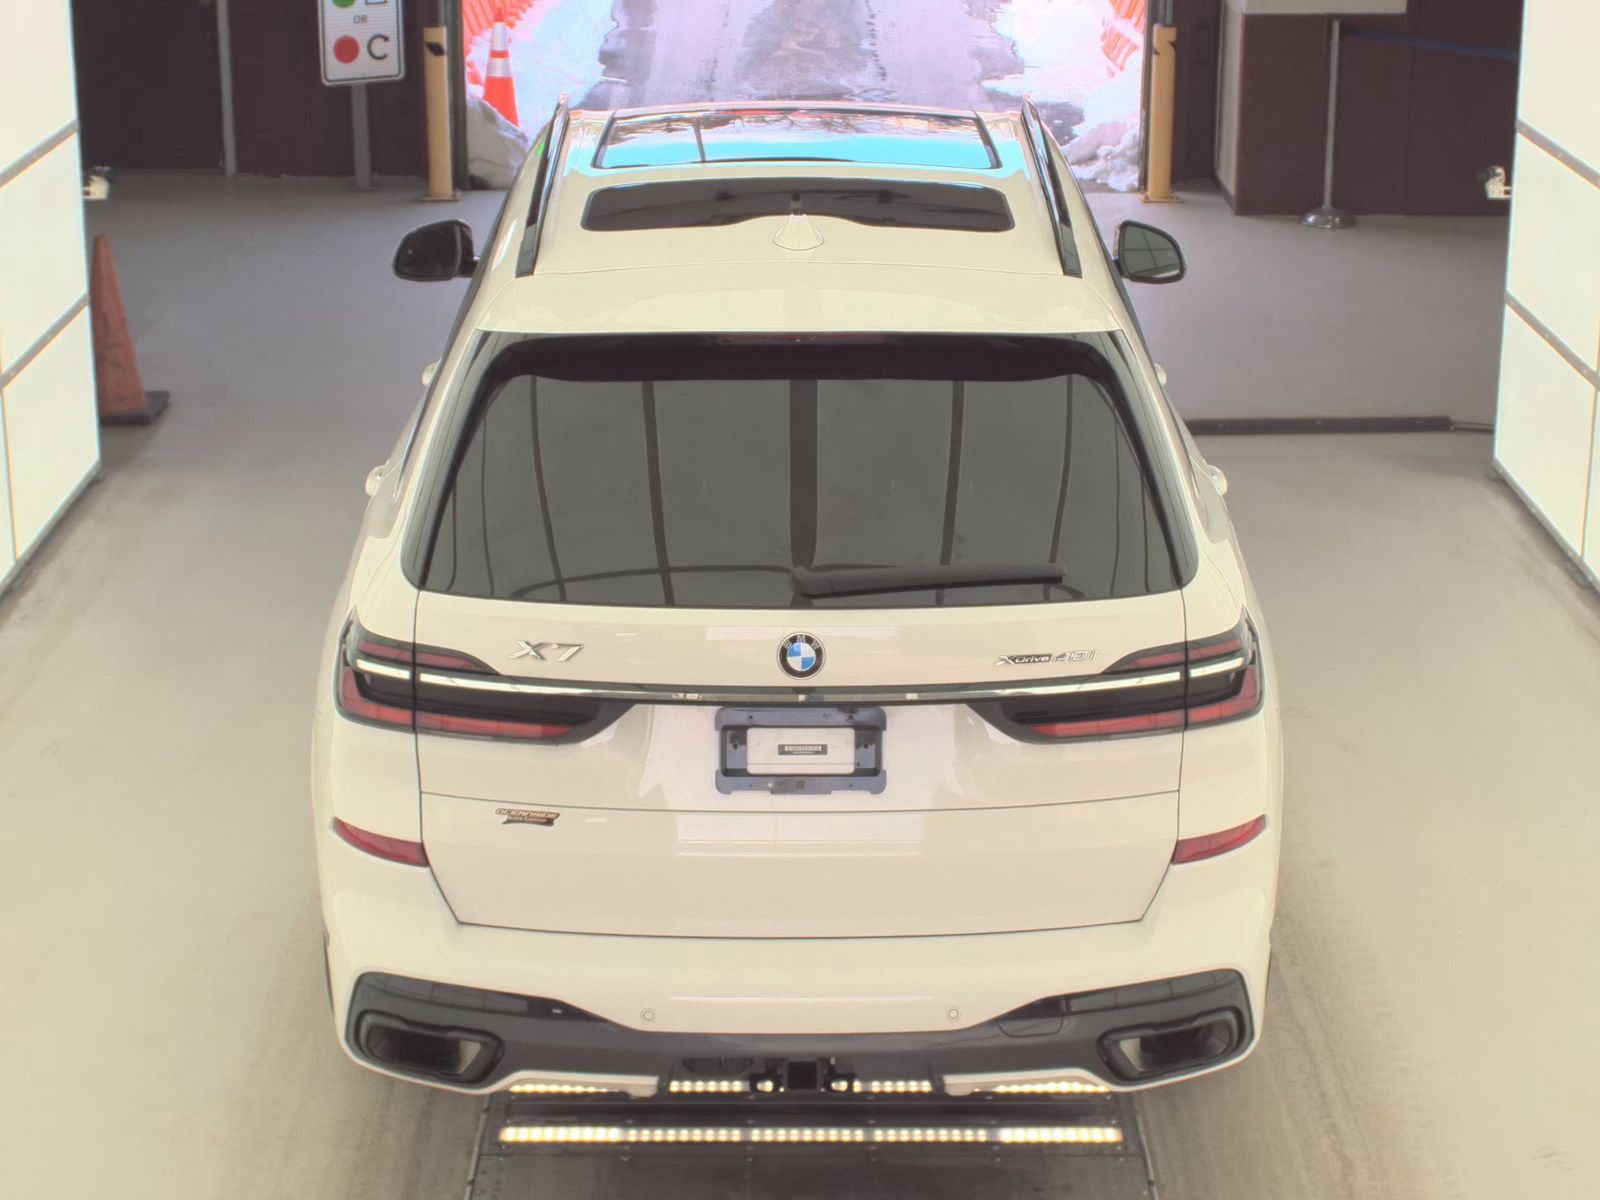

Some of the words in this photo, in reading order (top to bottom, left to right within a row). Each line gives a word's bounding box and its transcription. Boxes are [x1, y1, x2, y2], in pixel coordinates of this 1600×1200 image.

[353, 14, 368, 24] OR
[367, 34, 389, 60] C
[506, 639, 584, 661] X7
[782, 634, 820, 650] BMW
